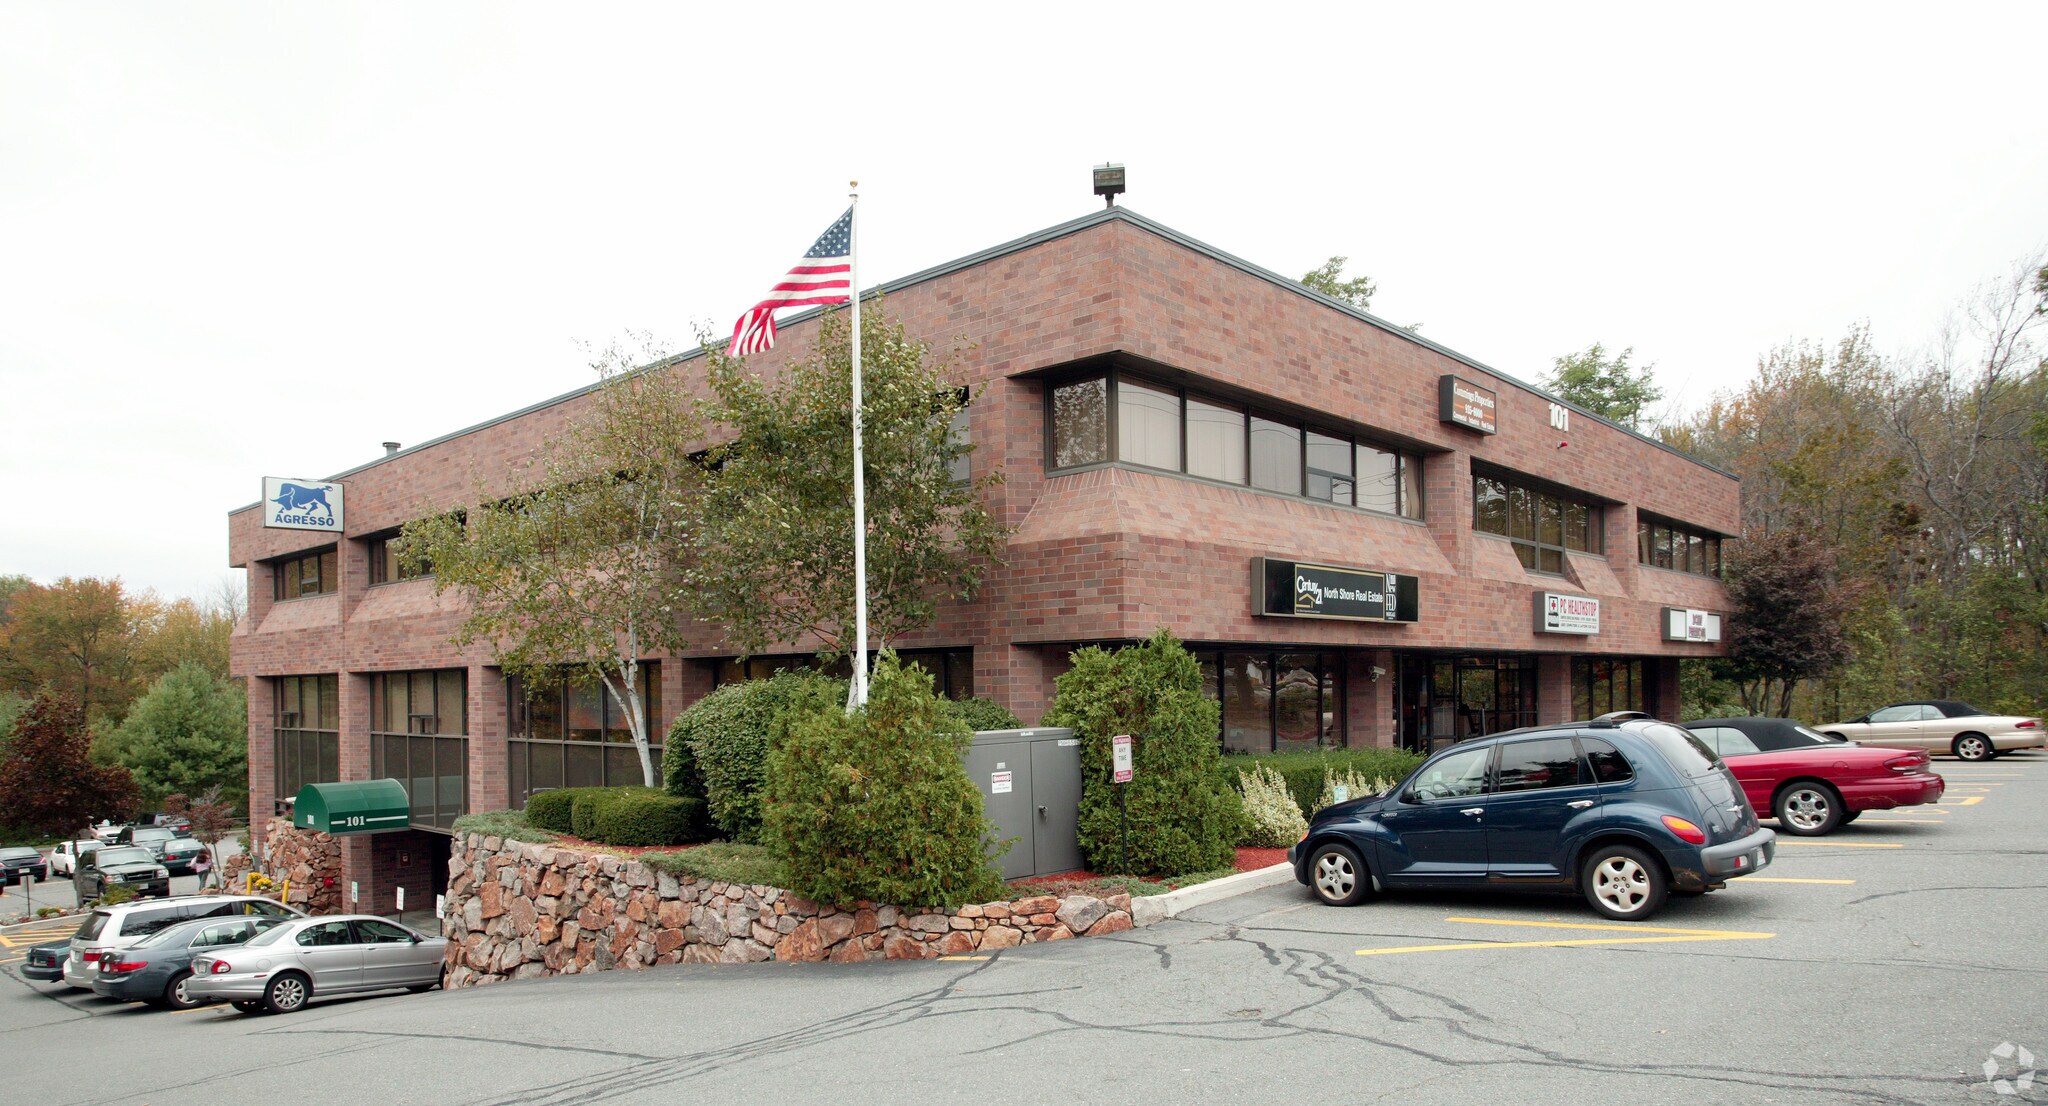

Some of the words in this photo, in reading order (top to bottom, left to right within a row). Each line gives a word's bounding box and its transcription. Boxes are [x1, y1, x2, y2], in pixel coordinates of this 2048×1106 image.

[1548, 402, 1569, 432] 101
[274, 514, 335, 527] AGRESSO
[1297, 575, 1318, 594] Century
[1315, 588, 1323, 604] 21
[1323, 587, 1339, 599] North
[1339, 588, 1355, 601] Shore
[1355, 590, 1367, 602] Real
[1368, 591, 1383, 603] Estate
[1560, 598, 1567, 614] PC
[1567, 599, 1597, 616] HEALTHSTOP
[347, 816, 365, 826] 101
